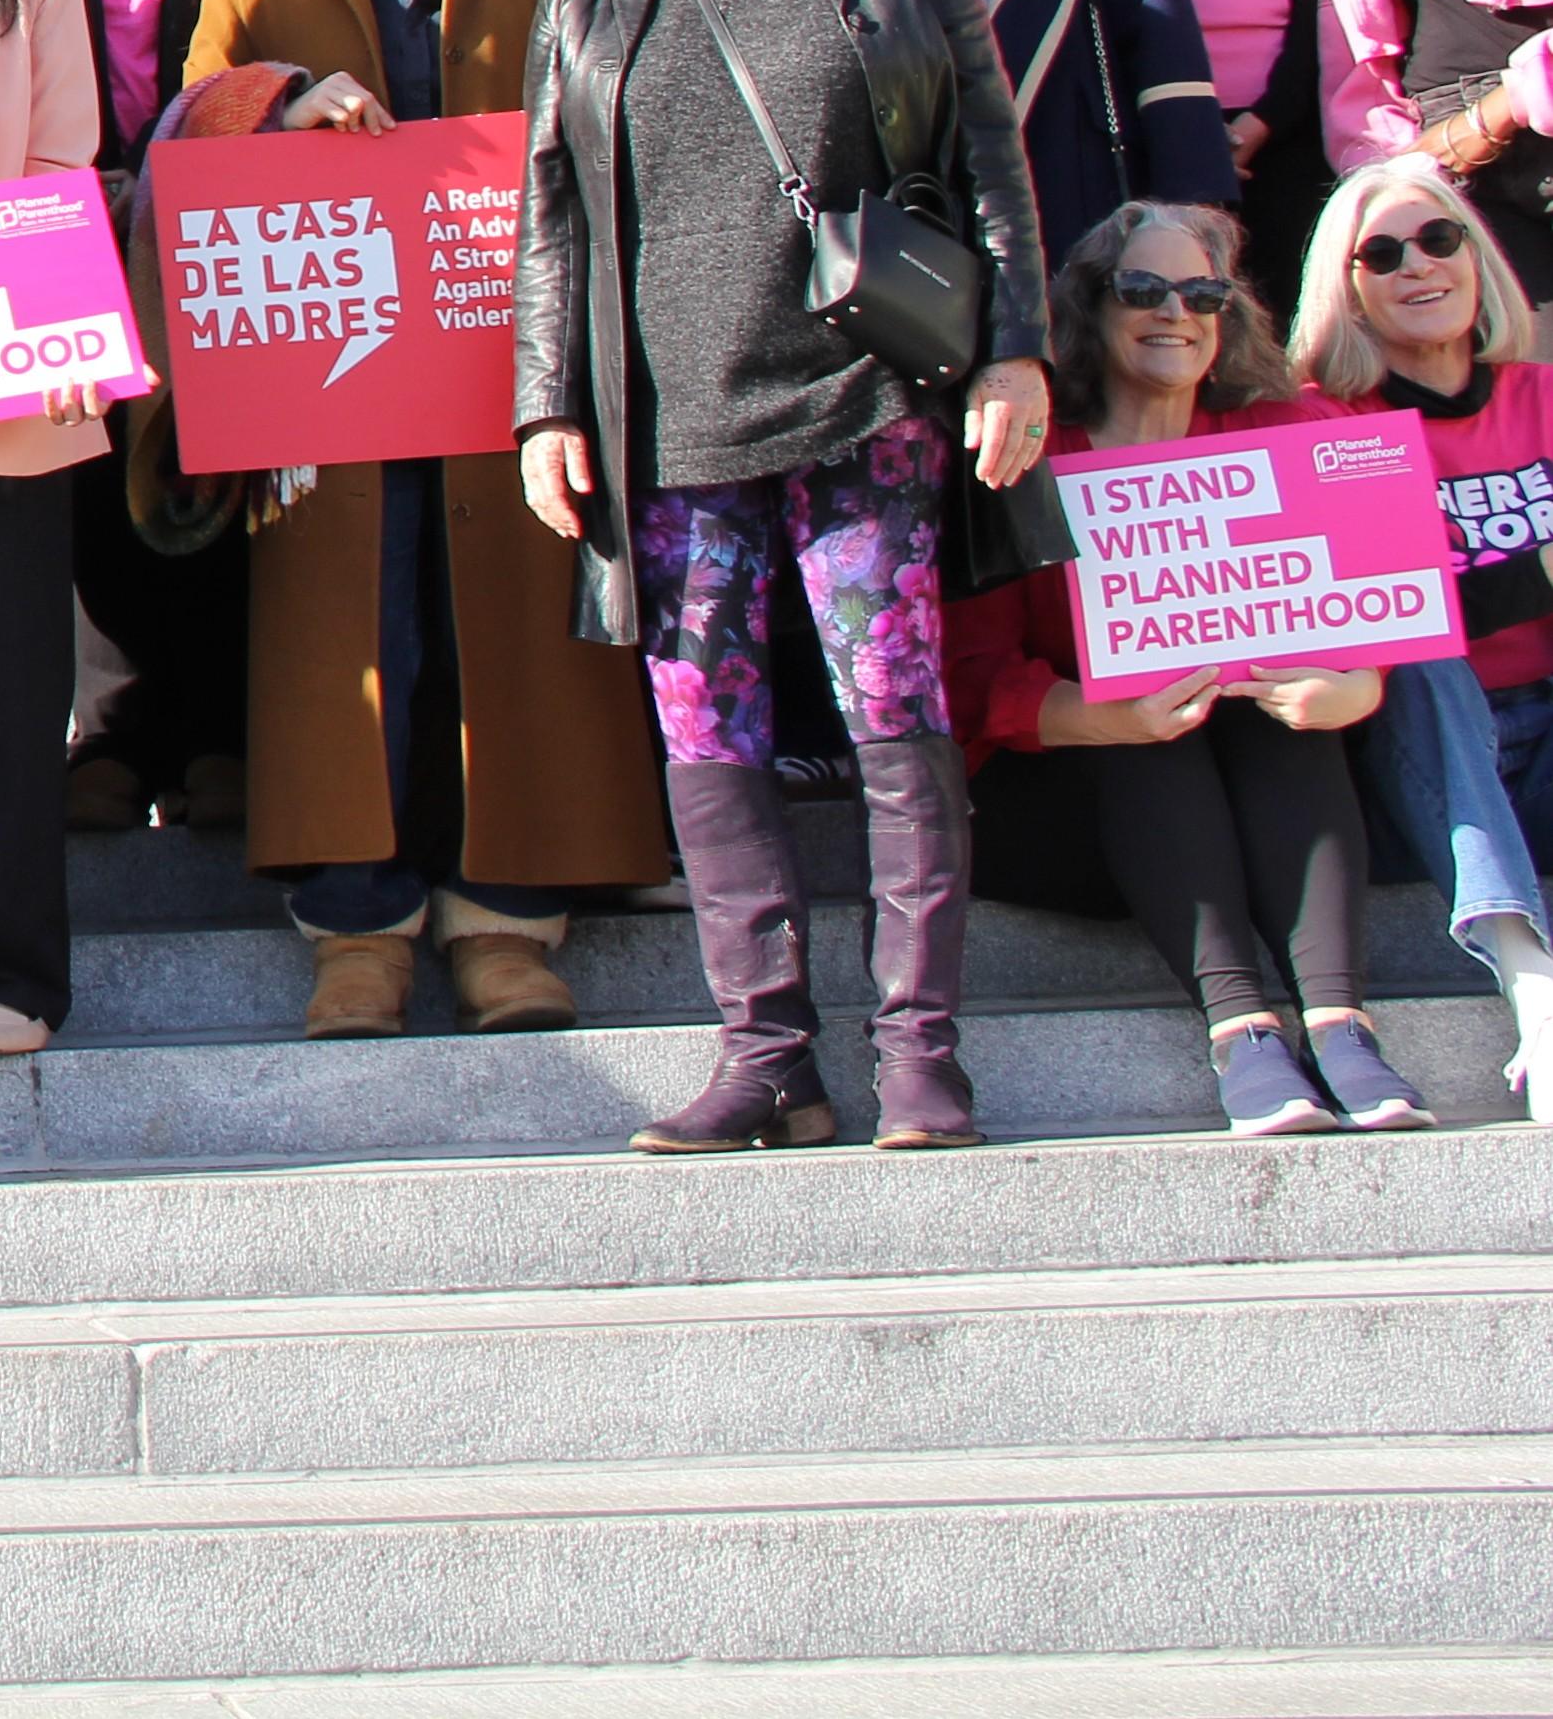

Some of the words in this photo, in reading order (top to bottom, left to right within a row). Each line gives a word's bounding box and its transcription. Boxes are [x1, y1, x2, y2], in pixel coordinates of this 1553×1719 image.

[177, 209, 240, 248] LA
[257, 196, 393, 243] CASA
[423, 190, 443, 214] A
[426, 220, 462, 243] An
[177, 257, 244, 299] DE
[262, 248, 364, 293] LAS
[429, 249, 450, 272] A
[185, 295, 402, 349] MADRES
[1335, 434, 1382, 451] Planned
[1339, 446, 1405, 463] Parenthood
[1080, 483, 1096, 516] I
[1106, 464, 1255, 514] STAND
[1089, 515, 1211, 561] WITH
[1101, 551, 1313, 609] PLANNED
[1107, 583, 1425, 655] PARENTHOOD
